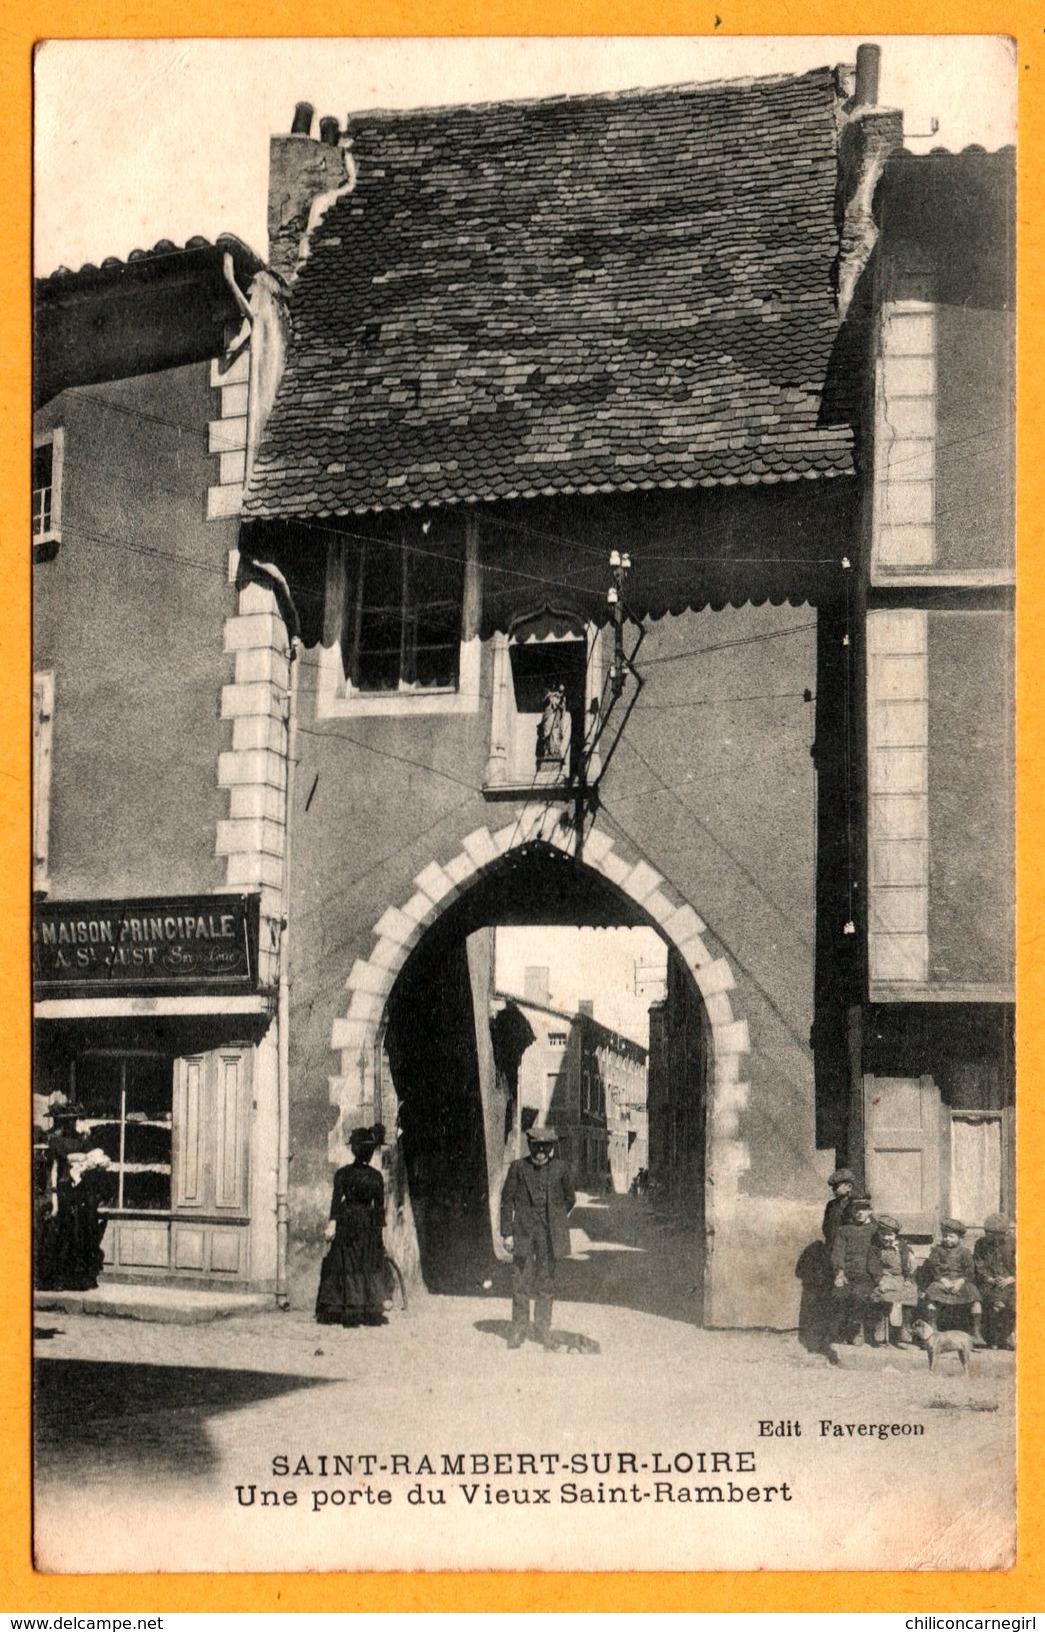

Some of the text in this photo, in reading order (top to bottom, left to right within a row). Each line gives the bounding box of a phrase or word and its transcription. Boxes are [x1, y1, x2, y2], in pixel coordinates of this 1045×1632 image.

[41, 915, 235, 945] MAISON PRINCIPALE
[105, 946, 157, 967] JUST
